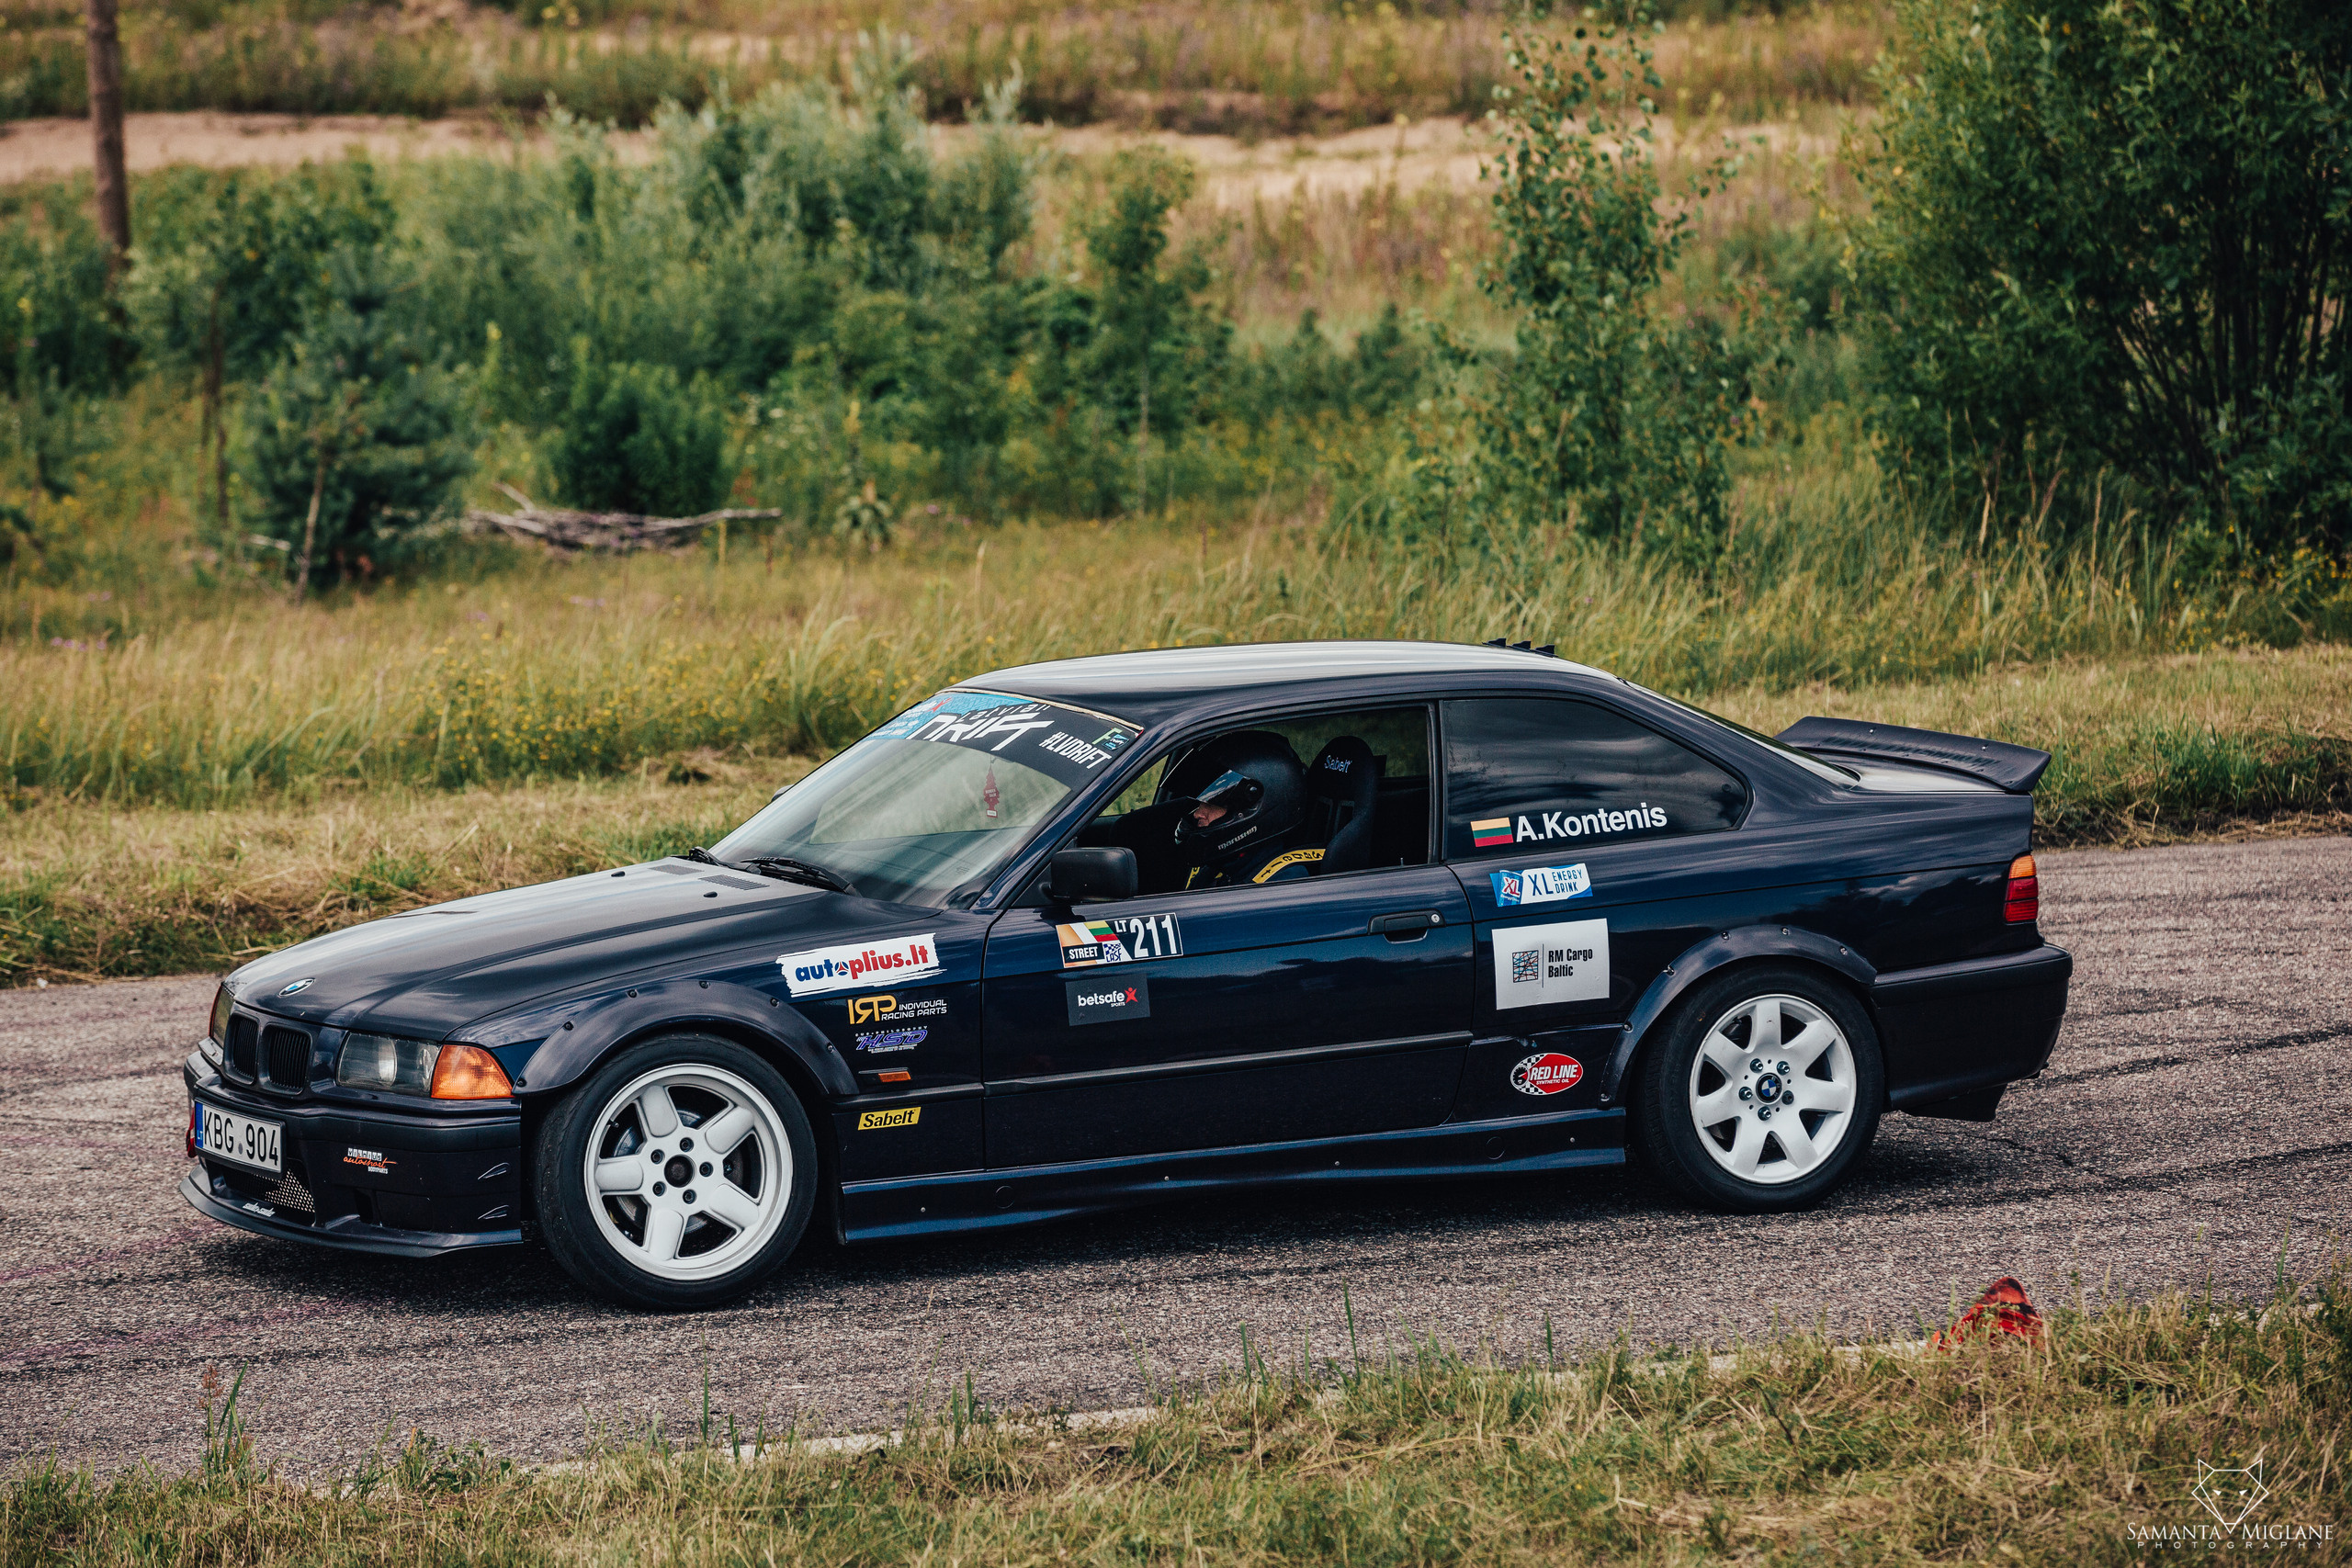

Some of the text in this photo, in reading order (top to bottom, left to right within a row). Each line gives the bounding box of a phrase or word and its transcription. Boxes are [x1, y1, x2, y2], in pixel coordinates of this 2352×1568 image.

[1038, 731, 1113, 770] #LVDRIFT
[1516, 802, 1668, 843] A.Kontenis
[1552, 869, 1583, 882] ENERGY
[1501, 875, 1521, 897] XL
[1528, 873, 1555, 897] XL
[1555, 882, 1578, 894] DRINK
[1114, 914, 1178, 959] LT 211
[1069, 946, 1099, 960] STREET
[1547, 948, 1593, 963] RM Cargo
[795, 943, 929, 982] autoplius.lt
[1547, 964, 1574, 978] Baltic
[899, 998, 948, 1011] INDIVIDUAL
[1077, 990, 1125, 1007] betsafe
[881, 1006, 947, 1021] RACING PARTS
[855, 1030, 929, 1051] HSD
[1530, 1064, 1578, 1081] RED LINE
[863, 1109, 915, 1128] Sabelt
[204, 1110, 278, 1167] KBG 904
